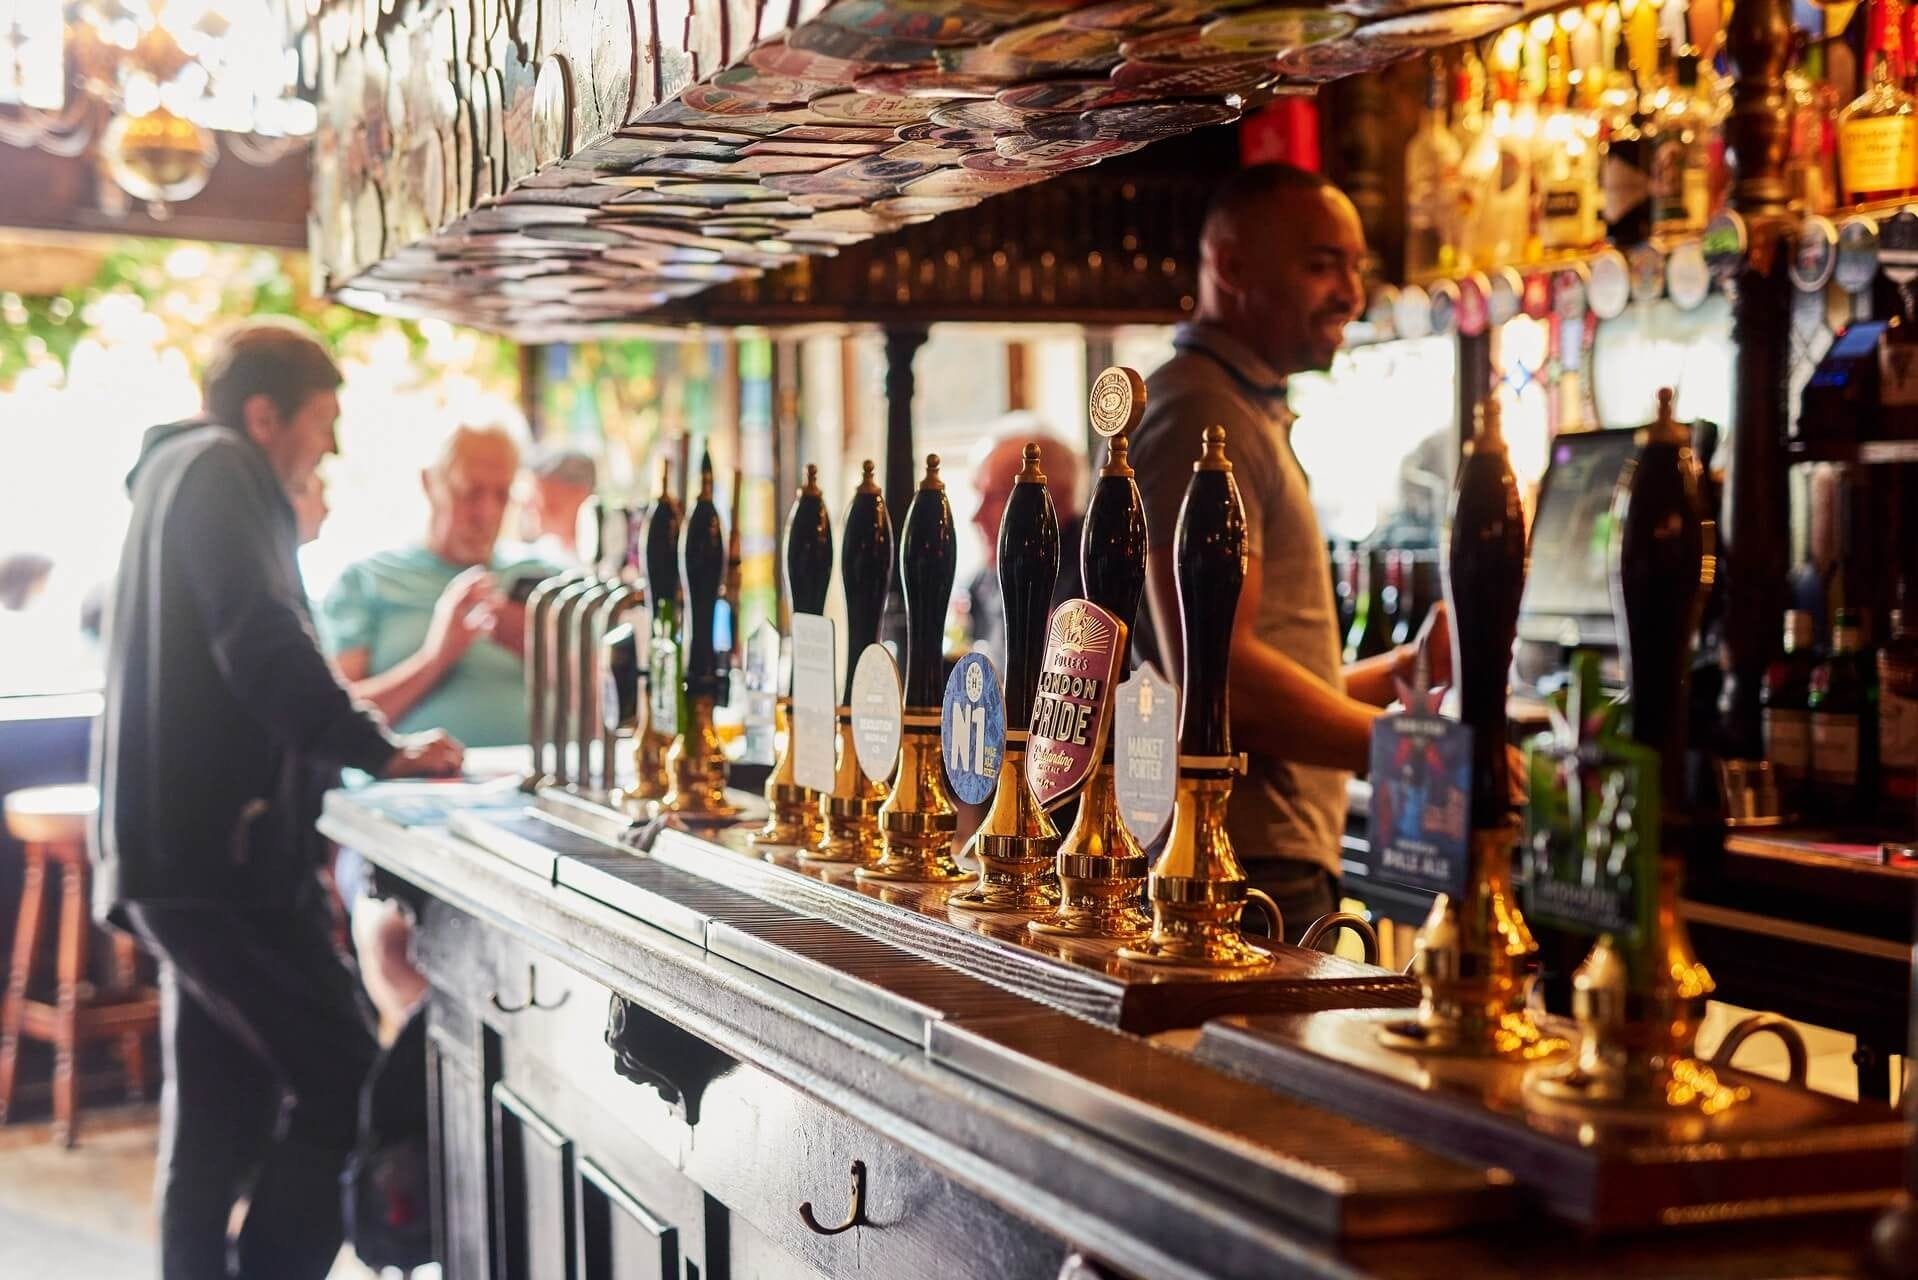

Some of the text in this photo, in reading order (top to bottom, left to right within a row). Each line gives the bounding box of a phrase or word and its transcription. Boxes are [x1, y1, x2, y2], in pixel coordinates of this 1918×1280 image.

[1053, 652, 1090, 672] FULLER'S
[1039, 671, 1098, 701] LONDON
[1030, 697, 1092, 745] PRIDE
[951, 702, 986, 776] N1
[1127, 736, 1165, 759] MARKET
[1128, 758, 1163, 781] PORTER
